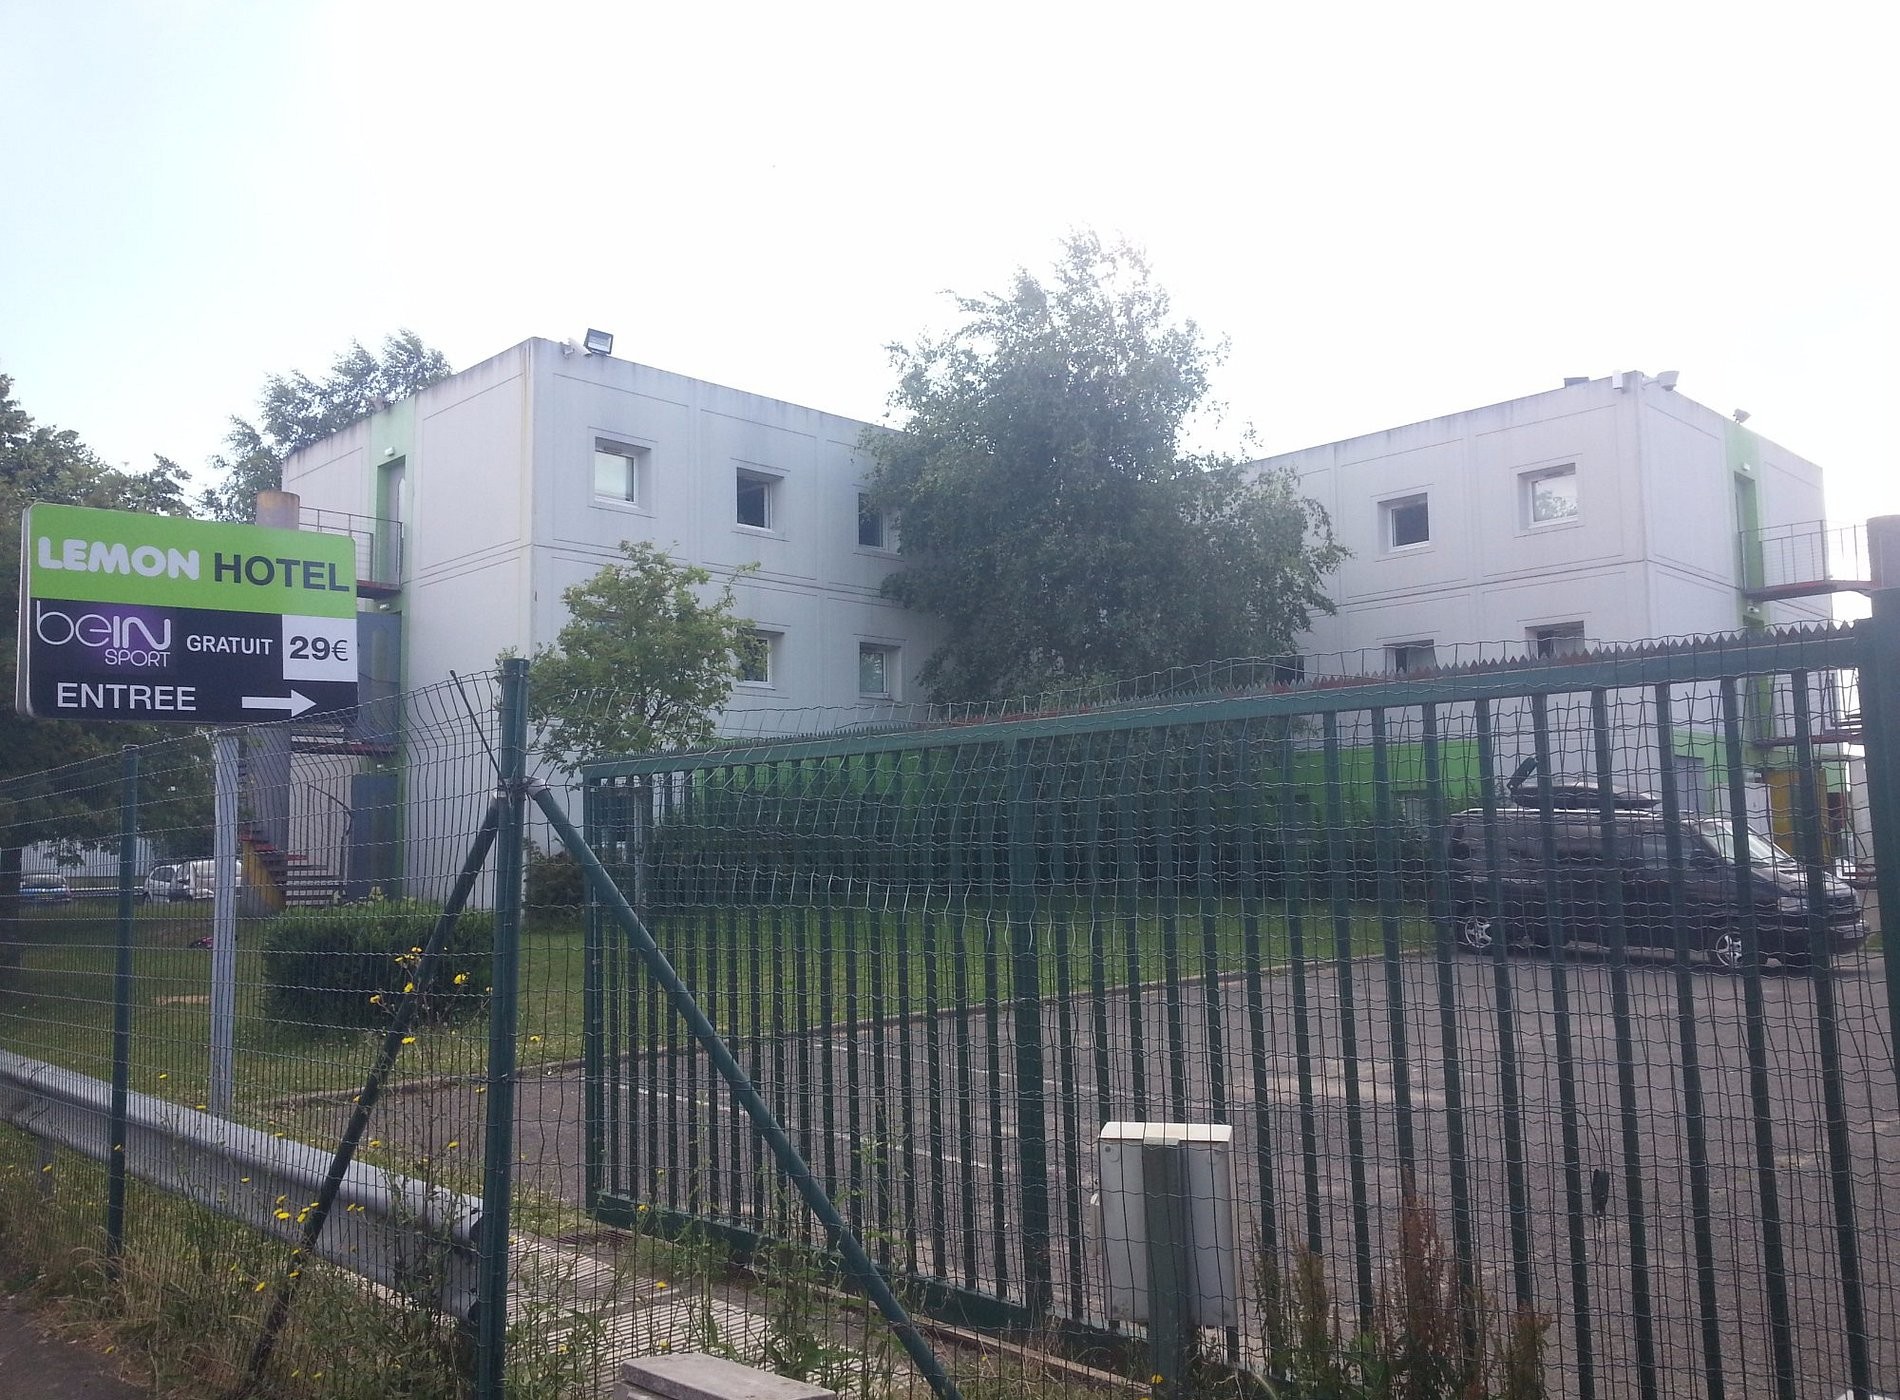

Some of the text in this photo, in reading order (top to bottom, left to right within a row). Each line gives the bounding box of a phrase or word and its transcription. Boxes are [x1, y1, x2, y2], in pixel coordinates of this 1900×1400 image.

[38, 536, 350, 592] LEMON HOTEL
[186, 634, 273, 655] GRATUIT
[289, 635, 349, 661] 29€
[105, 649, 171, 667] SPORT
[57, 682, 196, 711] ENTREE
